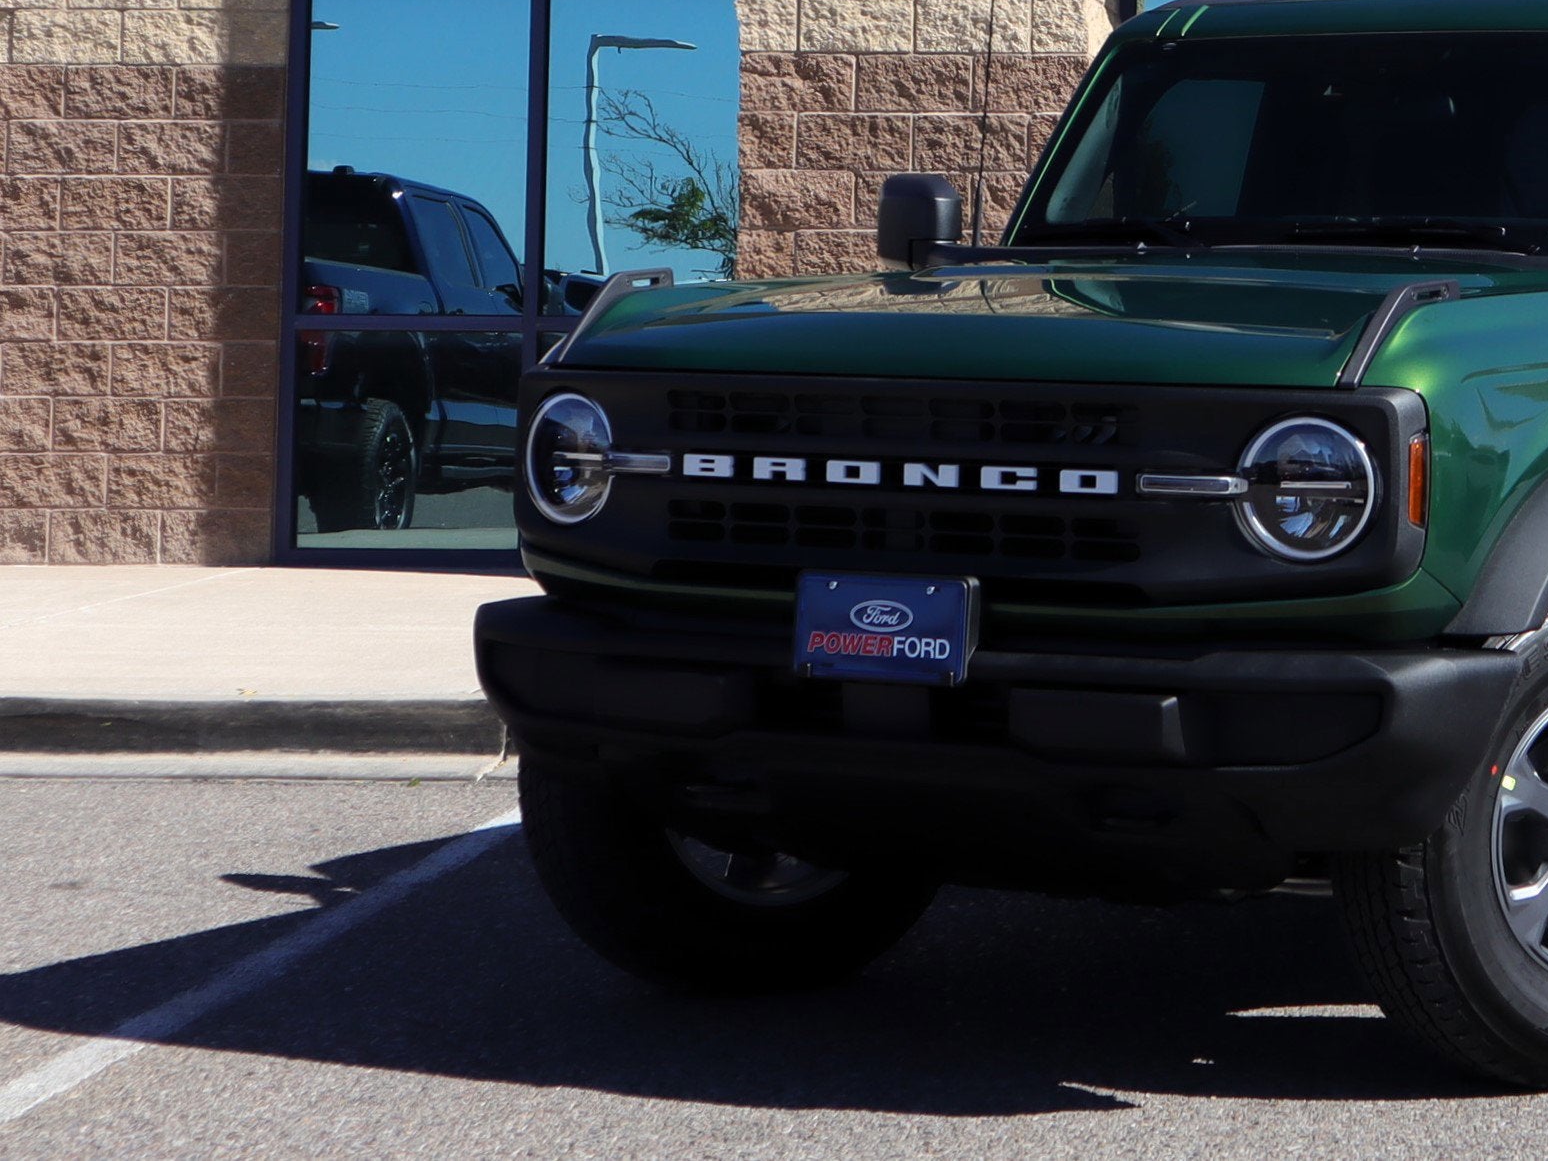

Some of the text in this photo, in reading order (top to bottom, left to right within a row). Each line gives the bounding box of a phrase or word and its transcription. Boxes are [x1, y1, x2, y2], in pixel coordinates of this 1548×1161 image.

[682, 453, 1118, 495] BRONCO
[862, 604, 901, 626] Ford
[807, 630, 951, 660] POWERFORD
